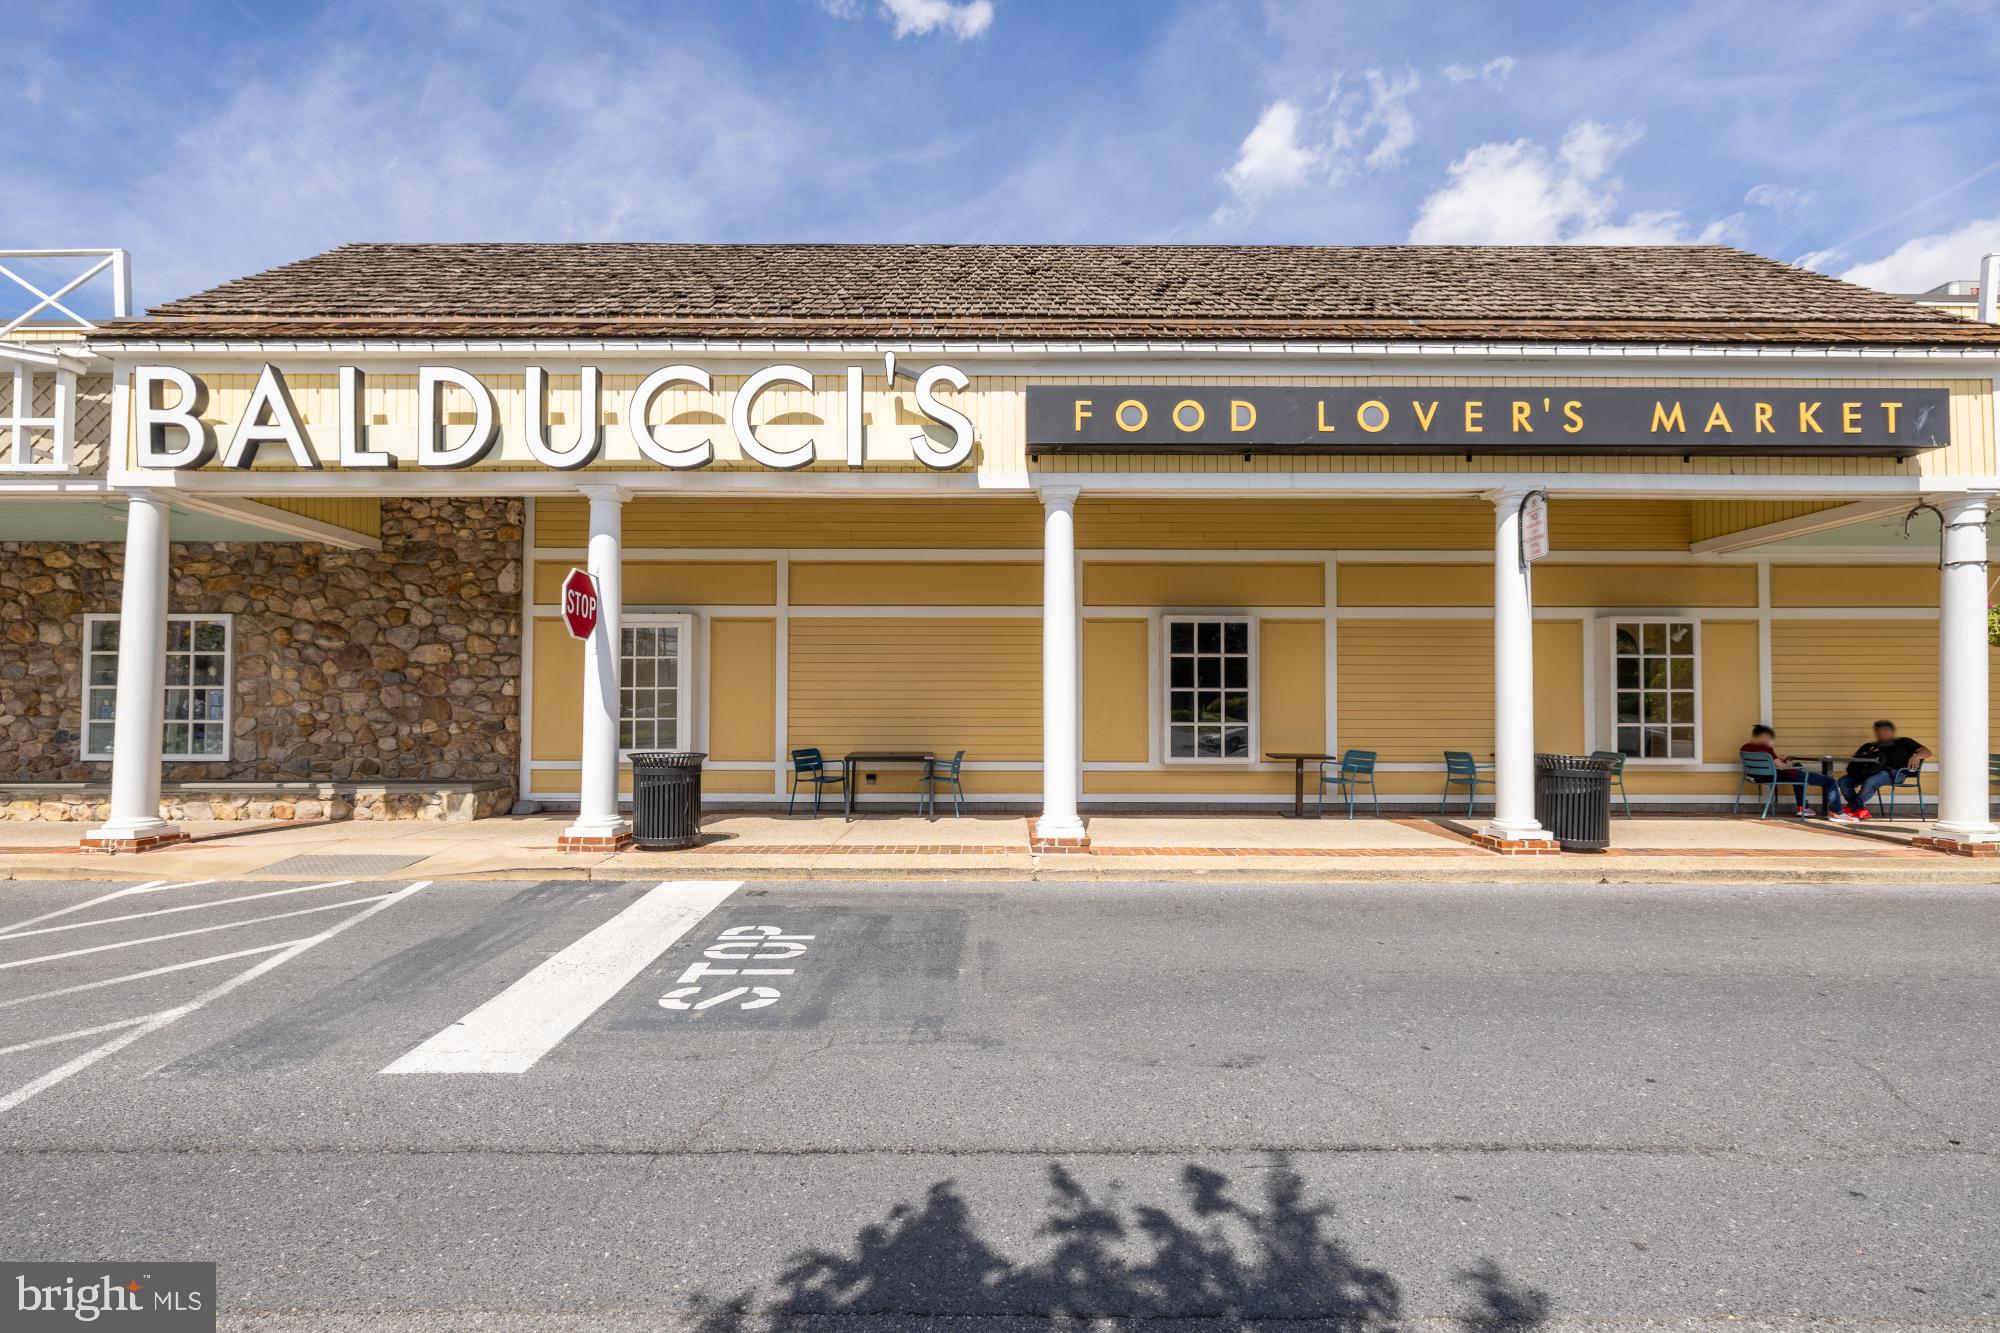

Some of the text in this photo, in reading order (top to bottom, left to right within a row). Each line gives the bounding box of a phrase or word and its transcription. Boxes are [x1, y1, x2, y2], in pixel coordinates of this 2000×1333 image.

[135, 351, 974, 470] BALDUCCI'S
[1075, 397, 1903, 434] FOOD LOVER'S MARKET
[567, 588, 597, 620] STOP
[658, 925, 816, 1010] STOP
